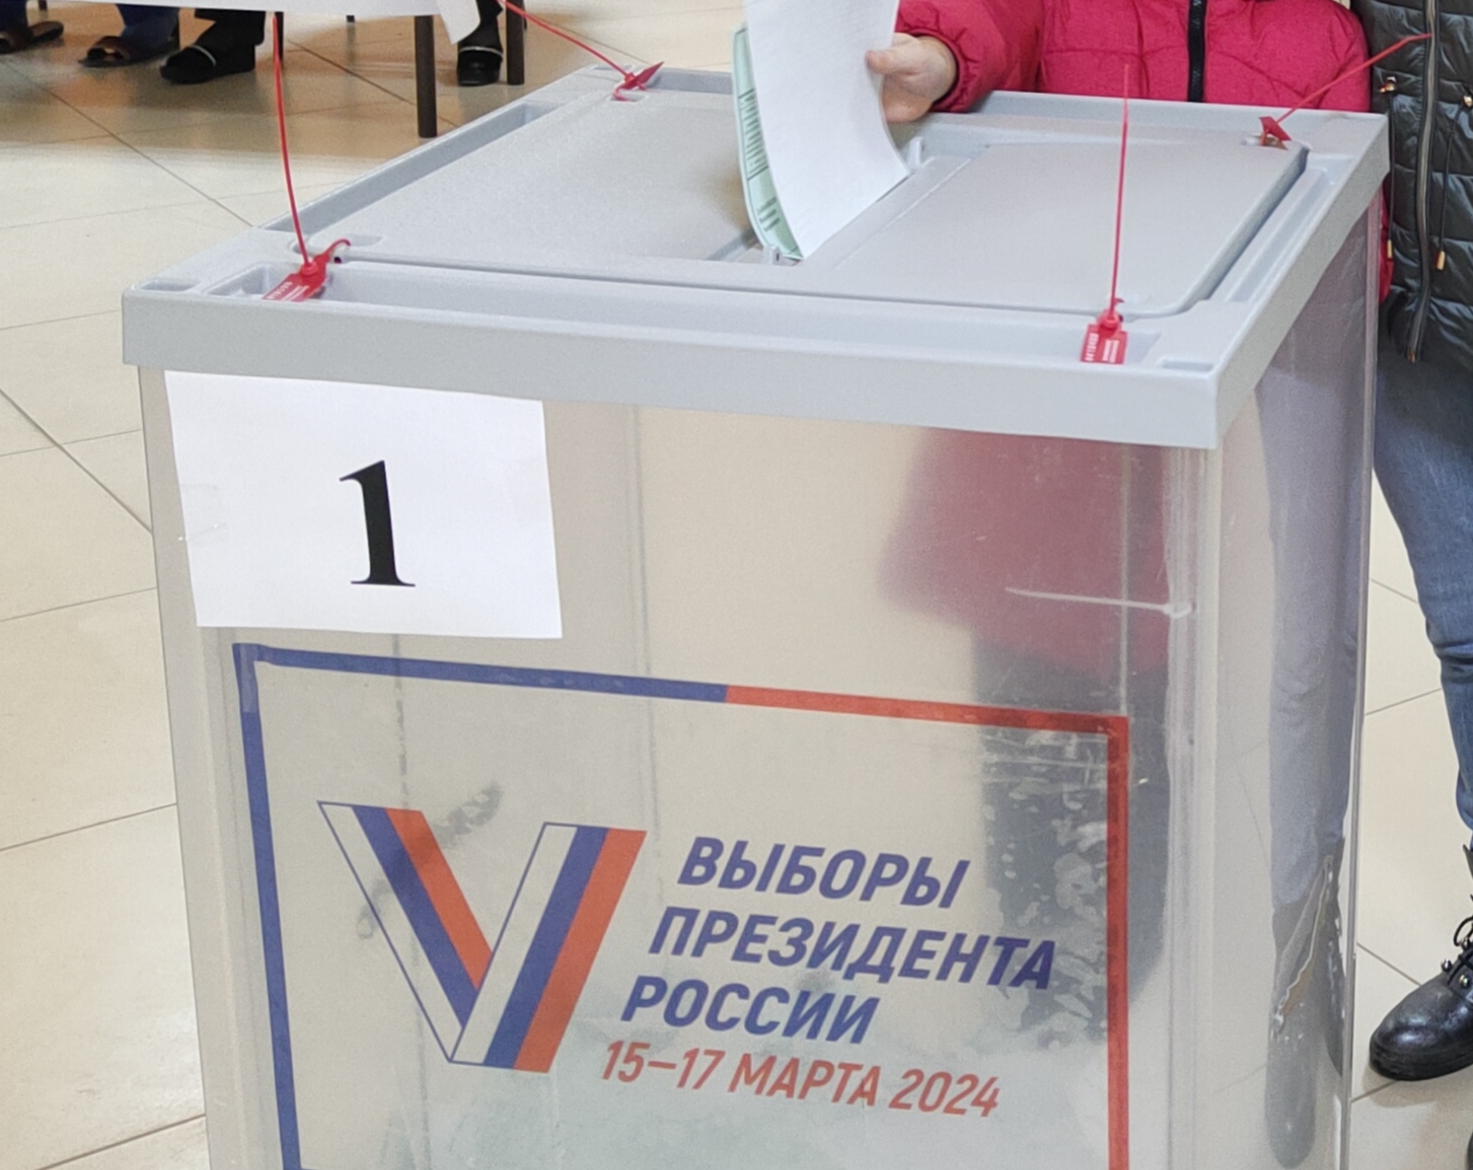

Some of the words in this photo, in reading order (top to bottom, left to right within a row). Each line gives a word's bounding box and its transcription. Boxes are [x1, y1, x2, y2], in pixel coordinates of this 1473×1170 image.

[339, 460, 416, 588] 1
[676, 836, 971, 909] ВЫБОРЫ
[648, 905, 1056, 990] ПРЕЗИДЕНТА
[620, 975, 880, 1045] РОССИИ
[727, 1053, 881, 1107] МАРТА
[888, 1067, 1000, 1118] 2024
